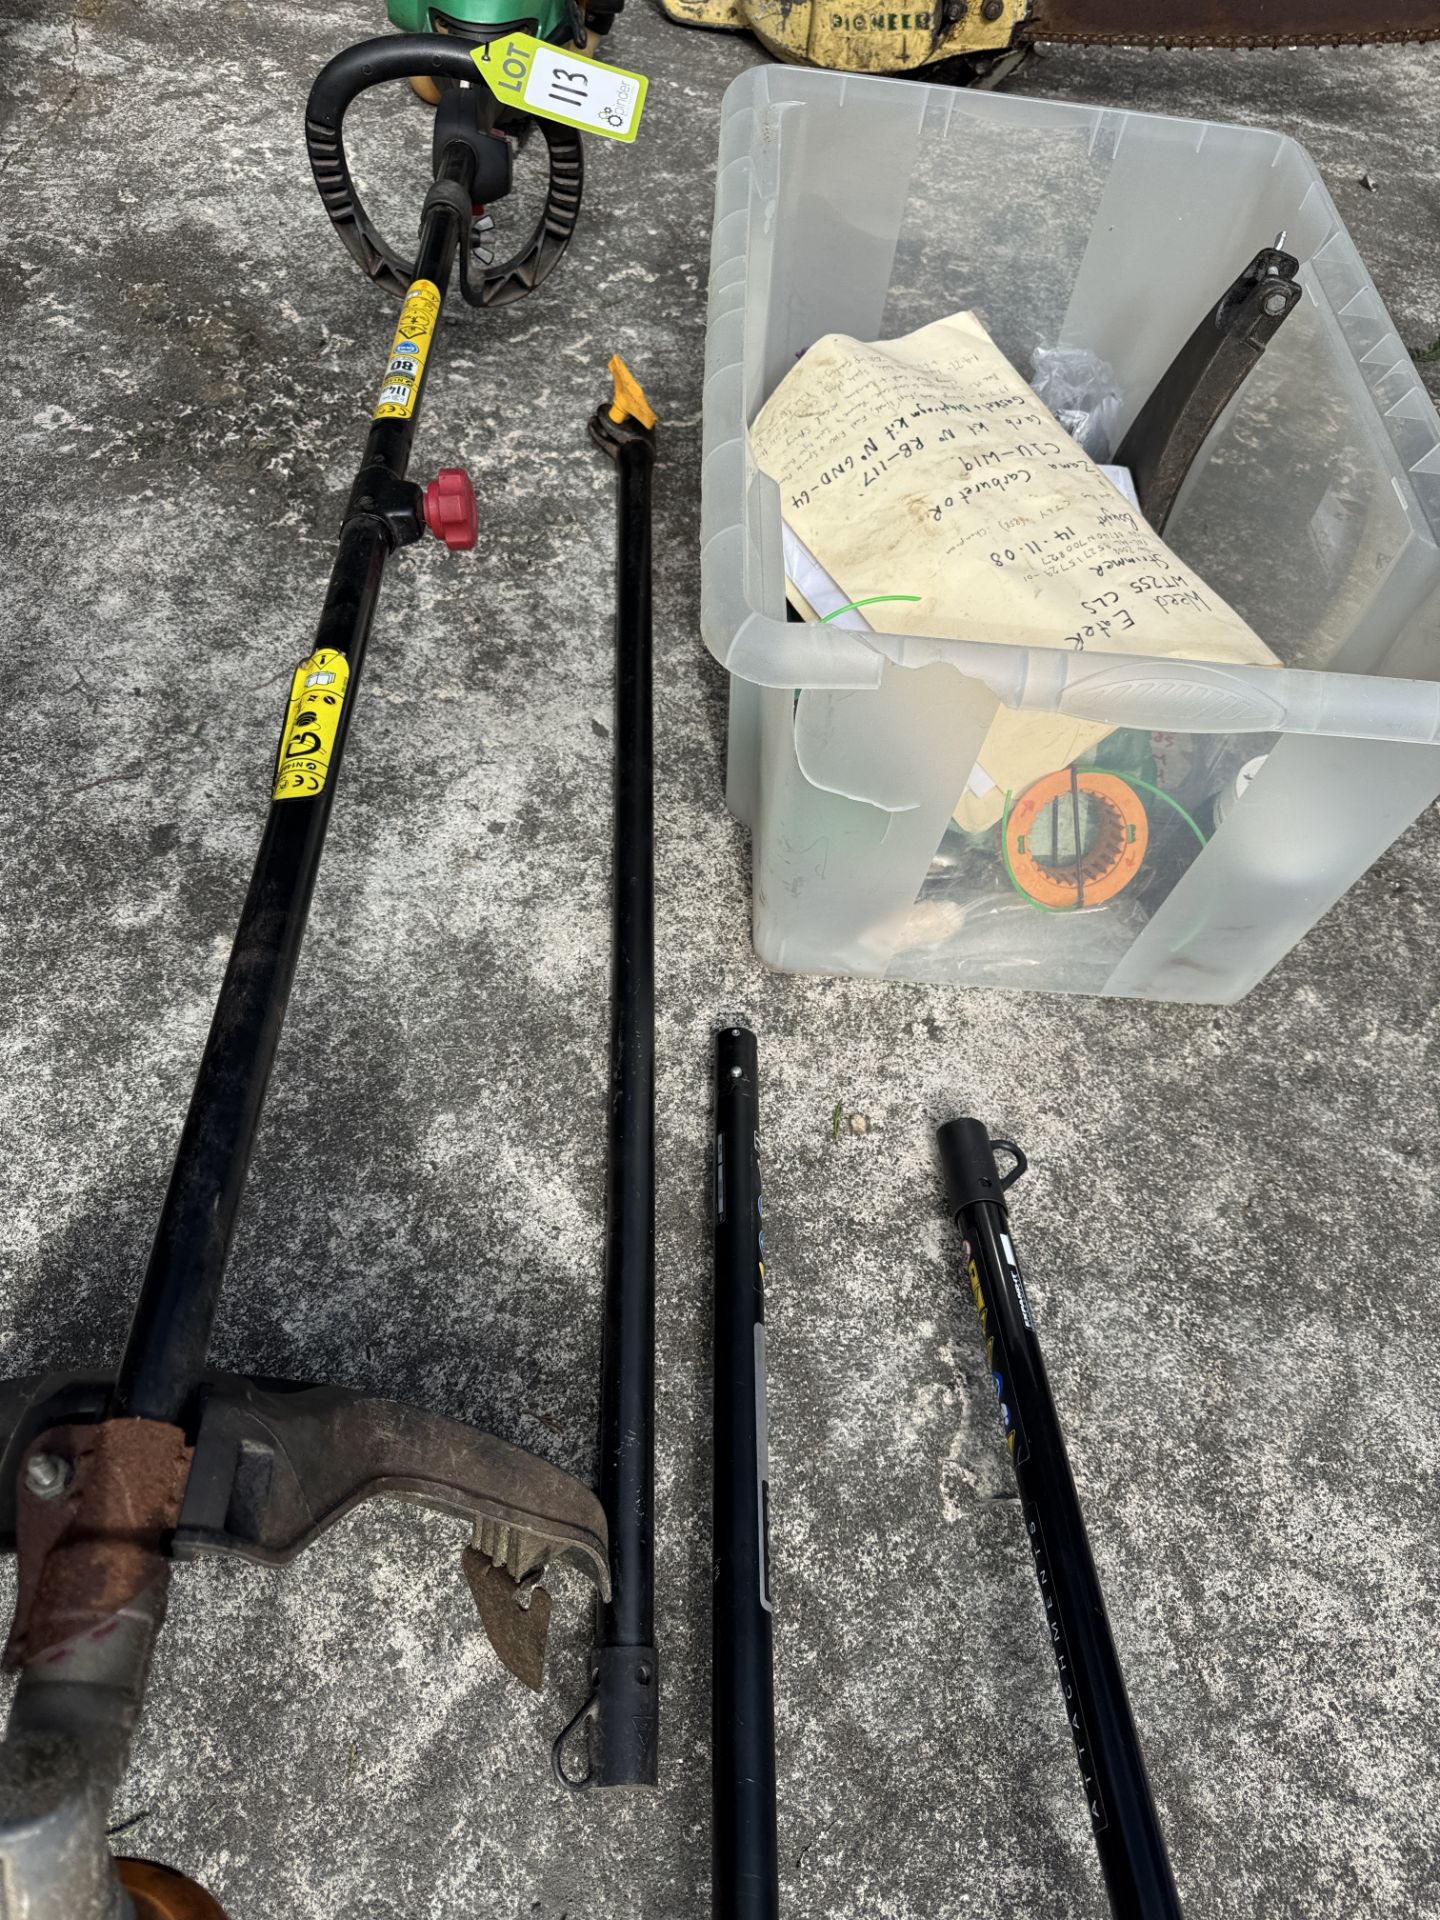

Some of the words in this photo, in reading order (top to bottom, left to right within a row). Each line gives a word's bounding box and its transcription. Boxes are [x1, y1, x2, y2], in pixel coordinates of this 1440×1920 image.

[498, 42, 530, 92] LOT
[548, 68, 588, 106] 113
[791, 456, 855, 509] GND-64
[1081, 591, 1119, 614] CLS
[1028, 1520, 1101, 1818] ATTACHMENTS
